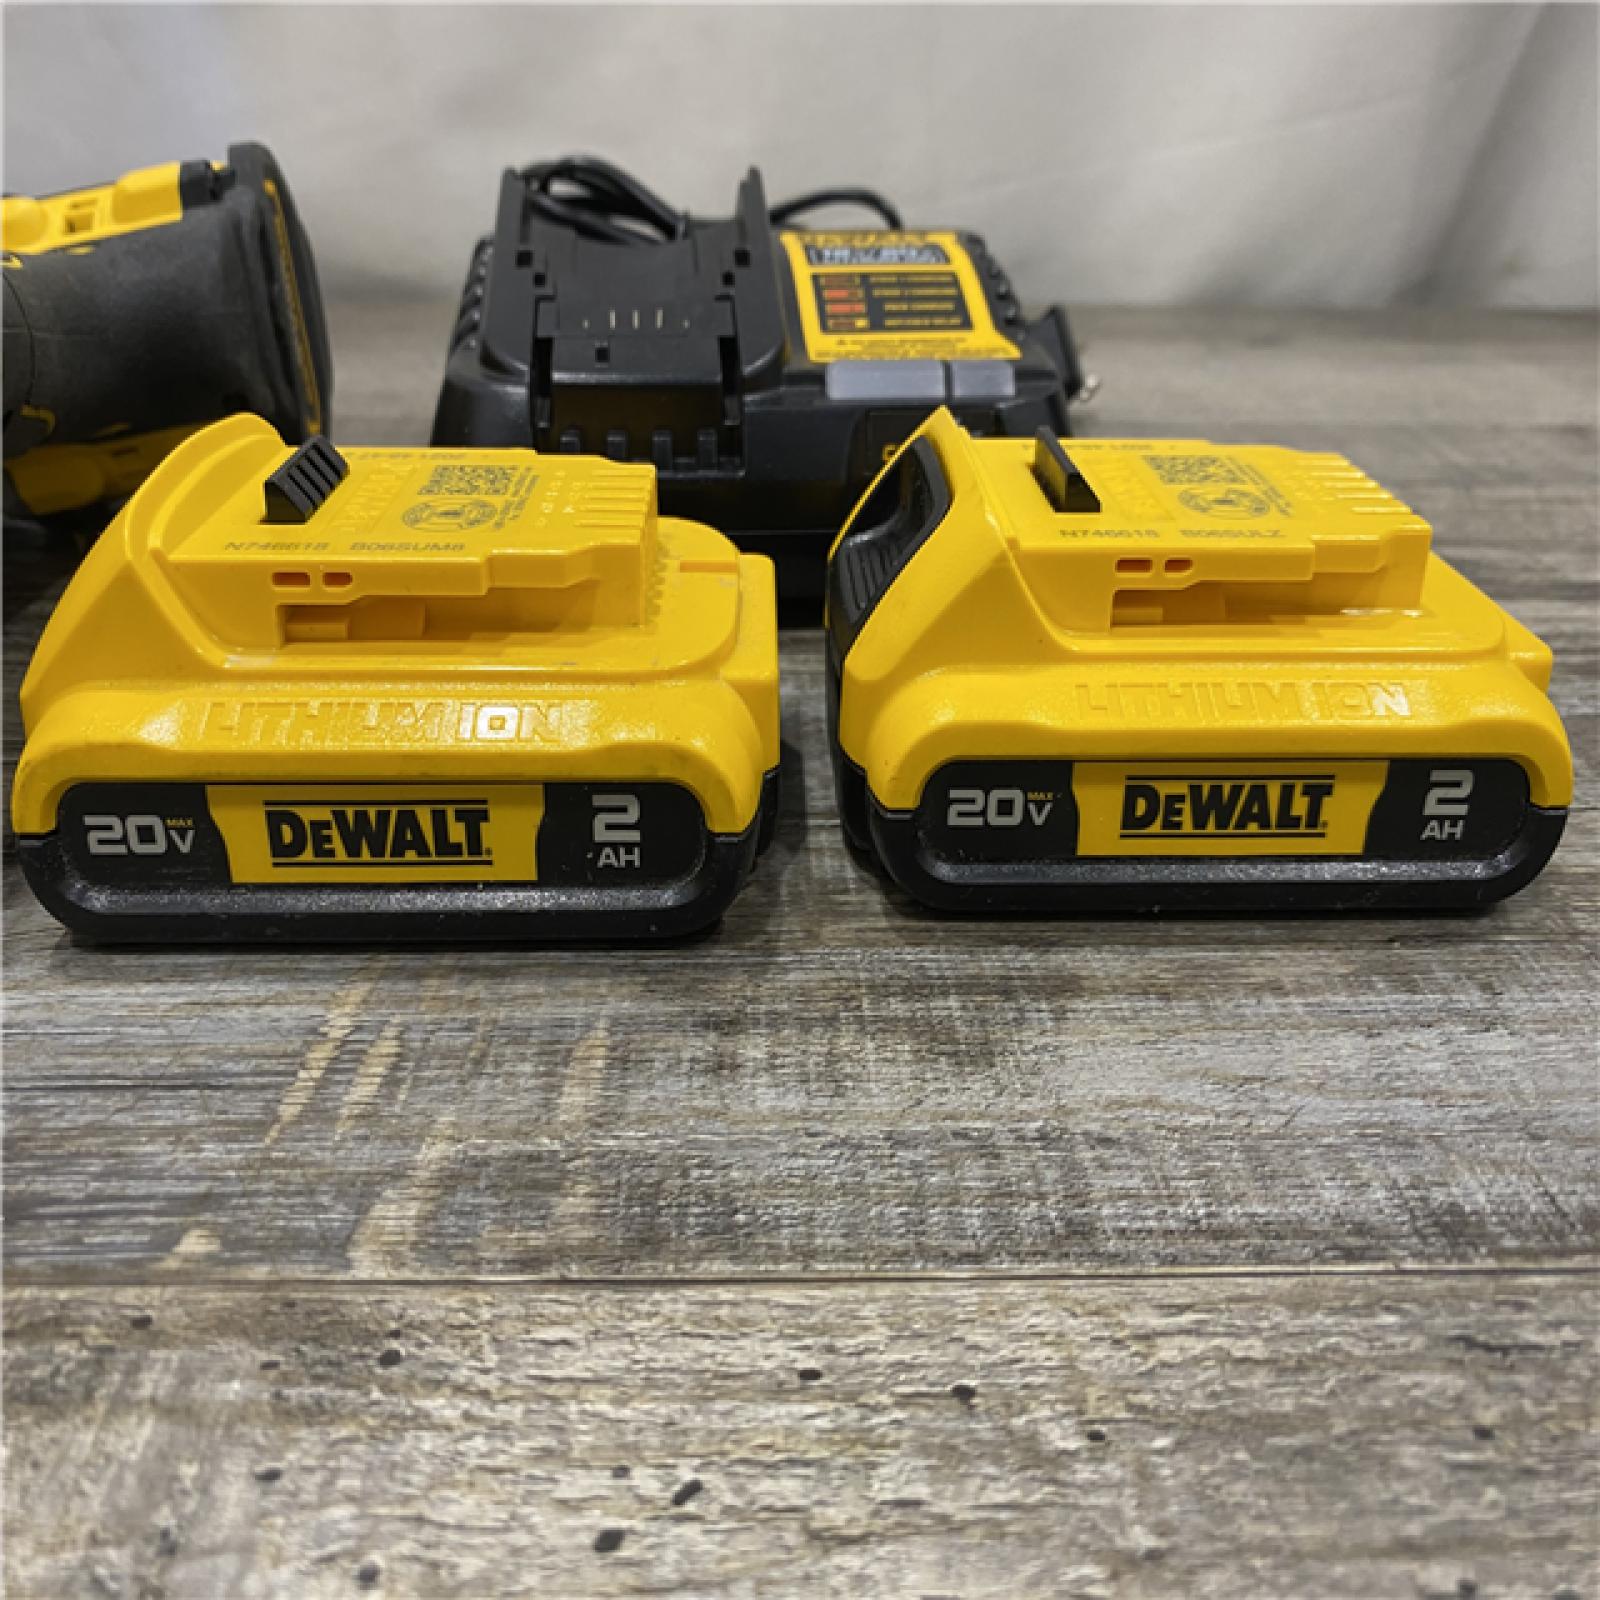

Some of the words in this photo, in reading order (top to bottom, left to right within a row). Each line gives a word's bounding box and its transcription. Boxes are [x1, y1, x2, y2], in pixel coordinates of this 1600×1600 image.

[1074, 682, 1301, 719] LITHIUM
[1311, 682, 1411, 719] ION
[198, 702, 452, 741] LITHIUM
[458, 702, 563, 742] ION
[1422, 769, 1475, 816] 2
[591, 794, 641, 844] 2
[1420, 819, 1465, 841] AH
[596, 847, 641, 869] AH
